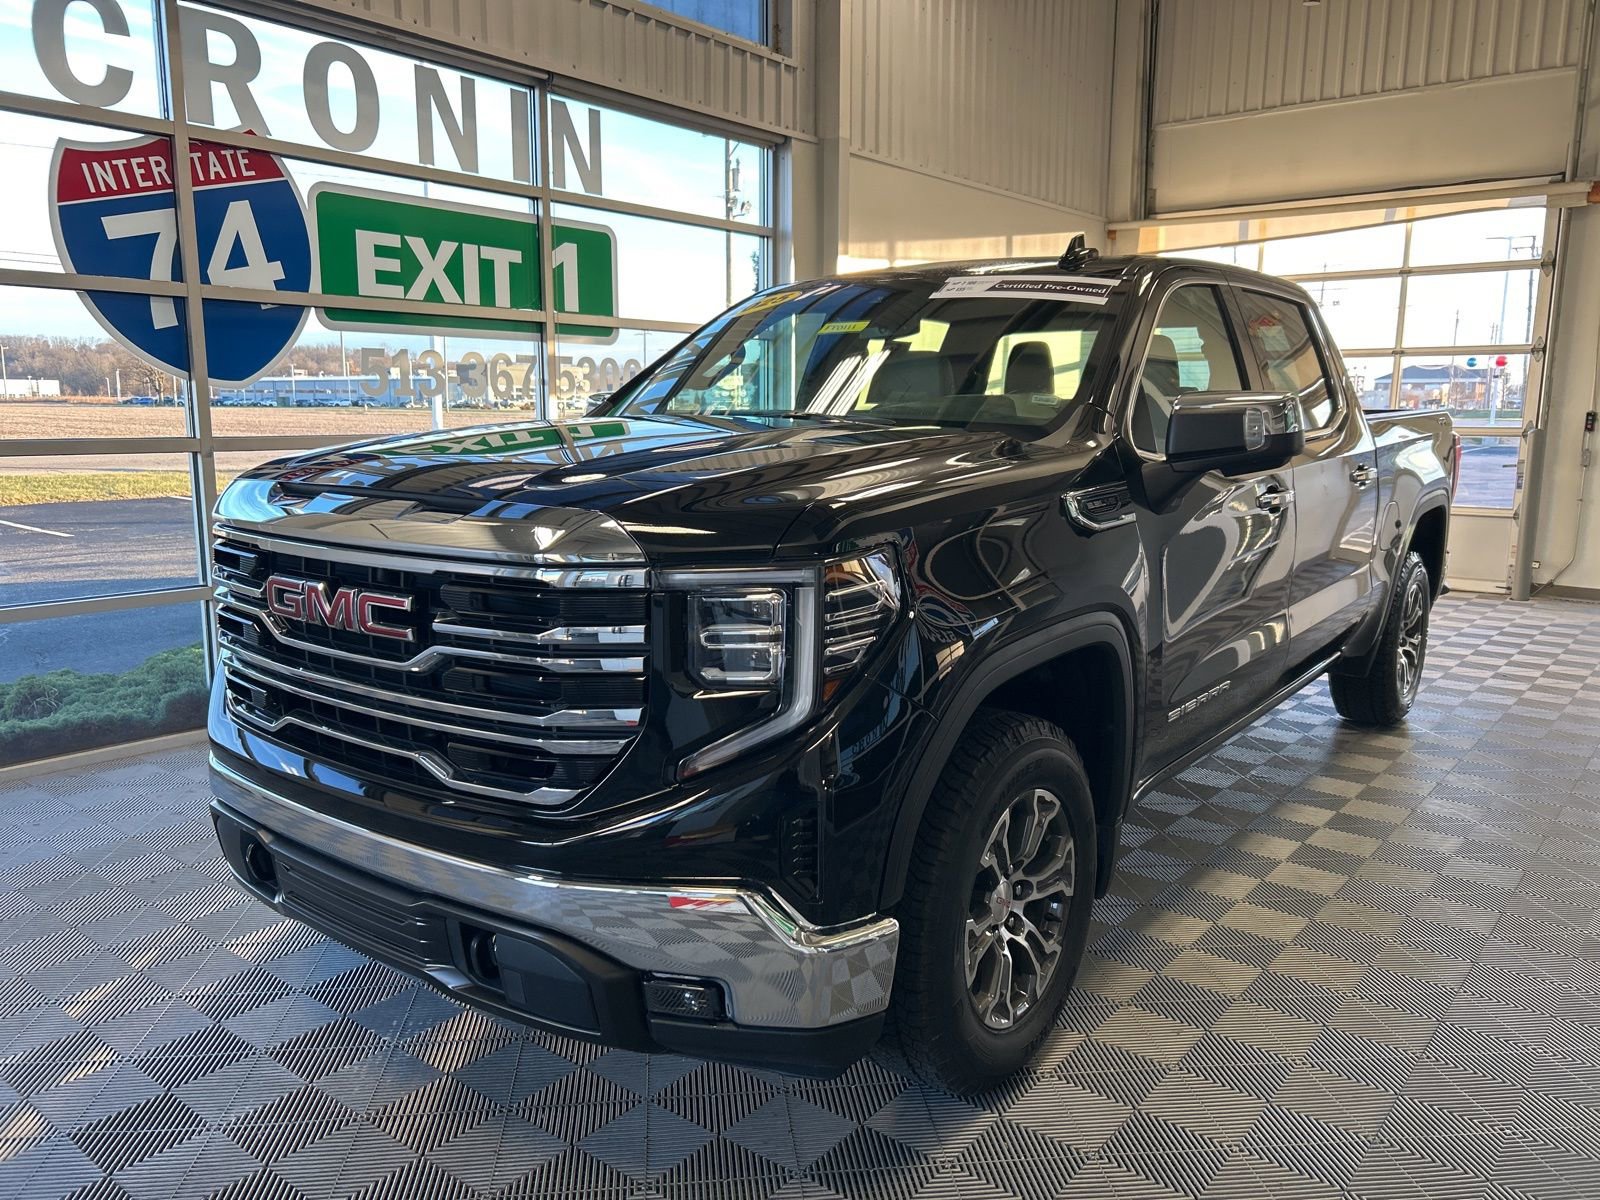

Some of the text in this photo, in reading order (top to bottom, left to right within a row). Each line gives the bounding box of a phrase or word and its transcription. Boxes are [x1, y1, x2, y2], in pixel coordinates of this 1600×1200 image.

[32, 0, 602, 196] CRONIN
[81, 149, 256, 194] INTERTATE
[101, 200, 286, 330] 74
[355, 229, 579, 313] EXIT 1
[994, 282, 1041, 291] Certified
[1044, 284, 1107, 294] Pre-Owned
[267, 574, 415, 641] GMC
[1167, 680, 1231, 723] SIERRA
